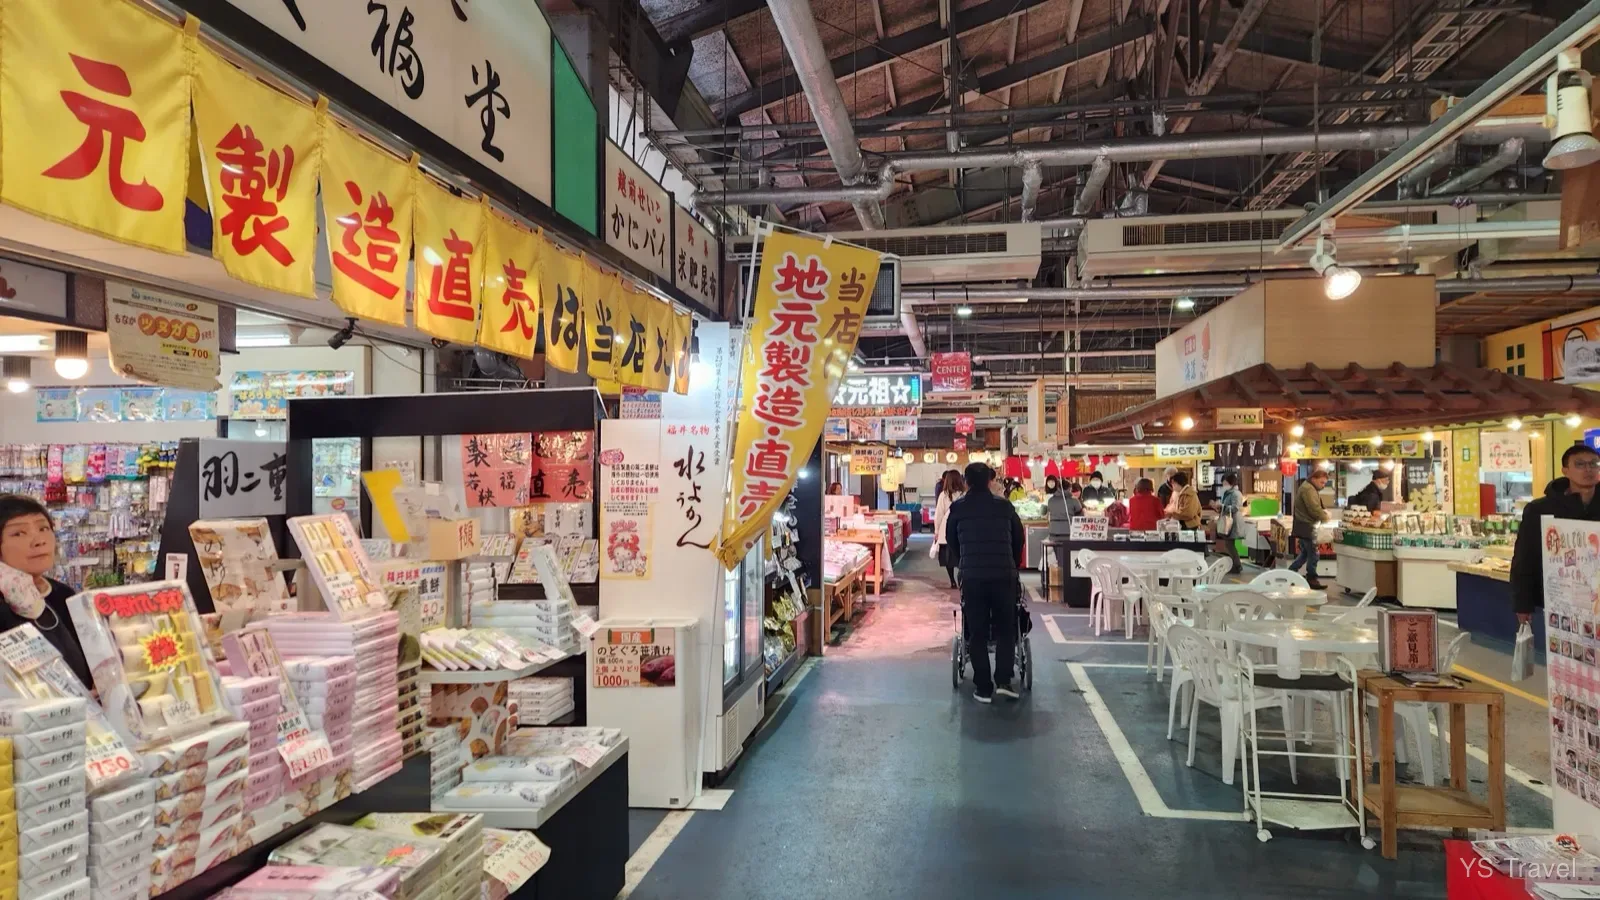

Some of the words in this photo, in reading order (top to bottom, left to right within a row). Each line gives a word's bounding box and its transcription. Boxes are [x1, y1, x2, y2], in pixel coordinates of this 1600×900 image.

[617, 167, 662, 224] 越前せいこ
[611, 204, 666, 268] かにパイ
[191, 348, 208, 359] 700
[936, 365, 967, 375] CENTER
[666, 425, 710, 436] 福井名物
[1161, 446, 1208, 456] こちらです。
[621, 632, 642, 643] 国産
[597, 645, 671, 656] のどぐろ笹漬け
[598, 675, 630, 686] 1000円
